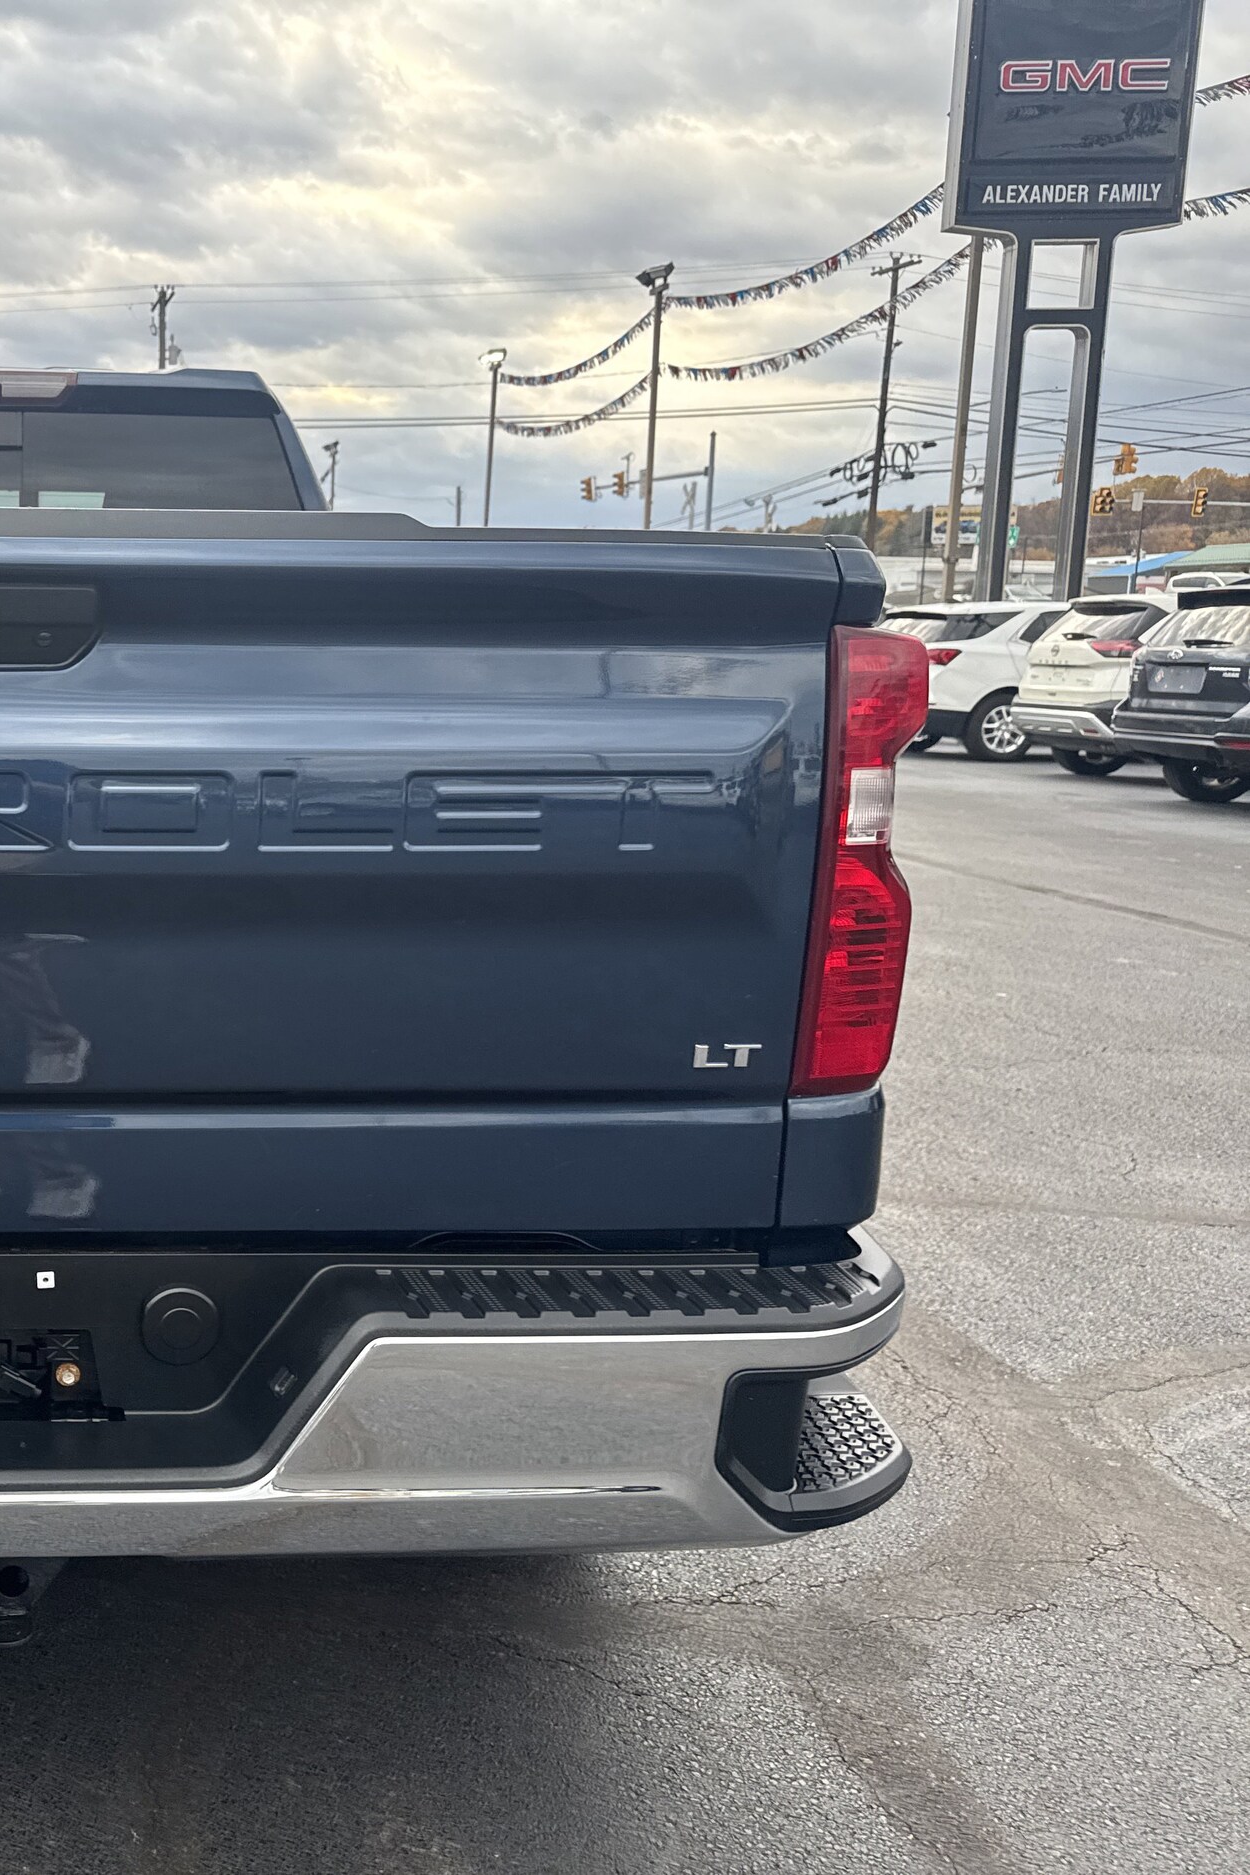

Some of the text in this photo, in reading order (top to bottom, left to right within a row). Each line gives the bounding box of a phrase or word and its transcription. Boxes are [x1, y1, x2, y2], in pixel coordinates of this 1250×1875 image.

[1000, 58, 1171, 92] GMC
[982, 183, 1162, 204] ALEXANDER FAMILY
[692, 1043, 762, 1068] LT
